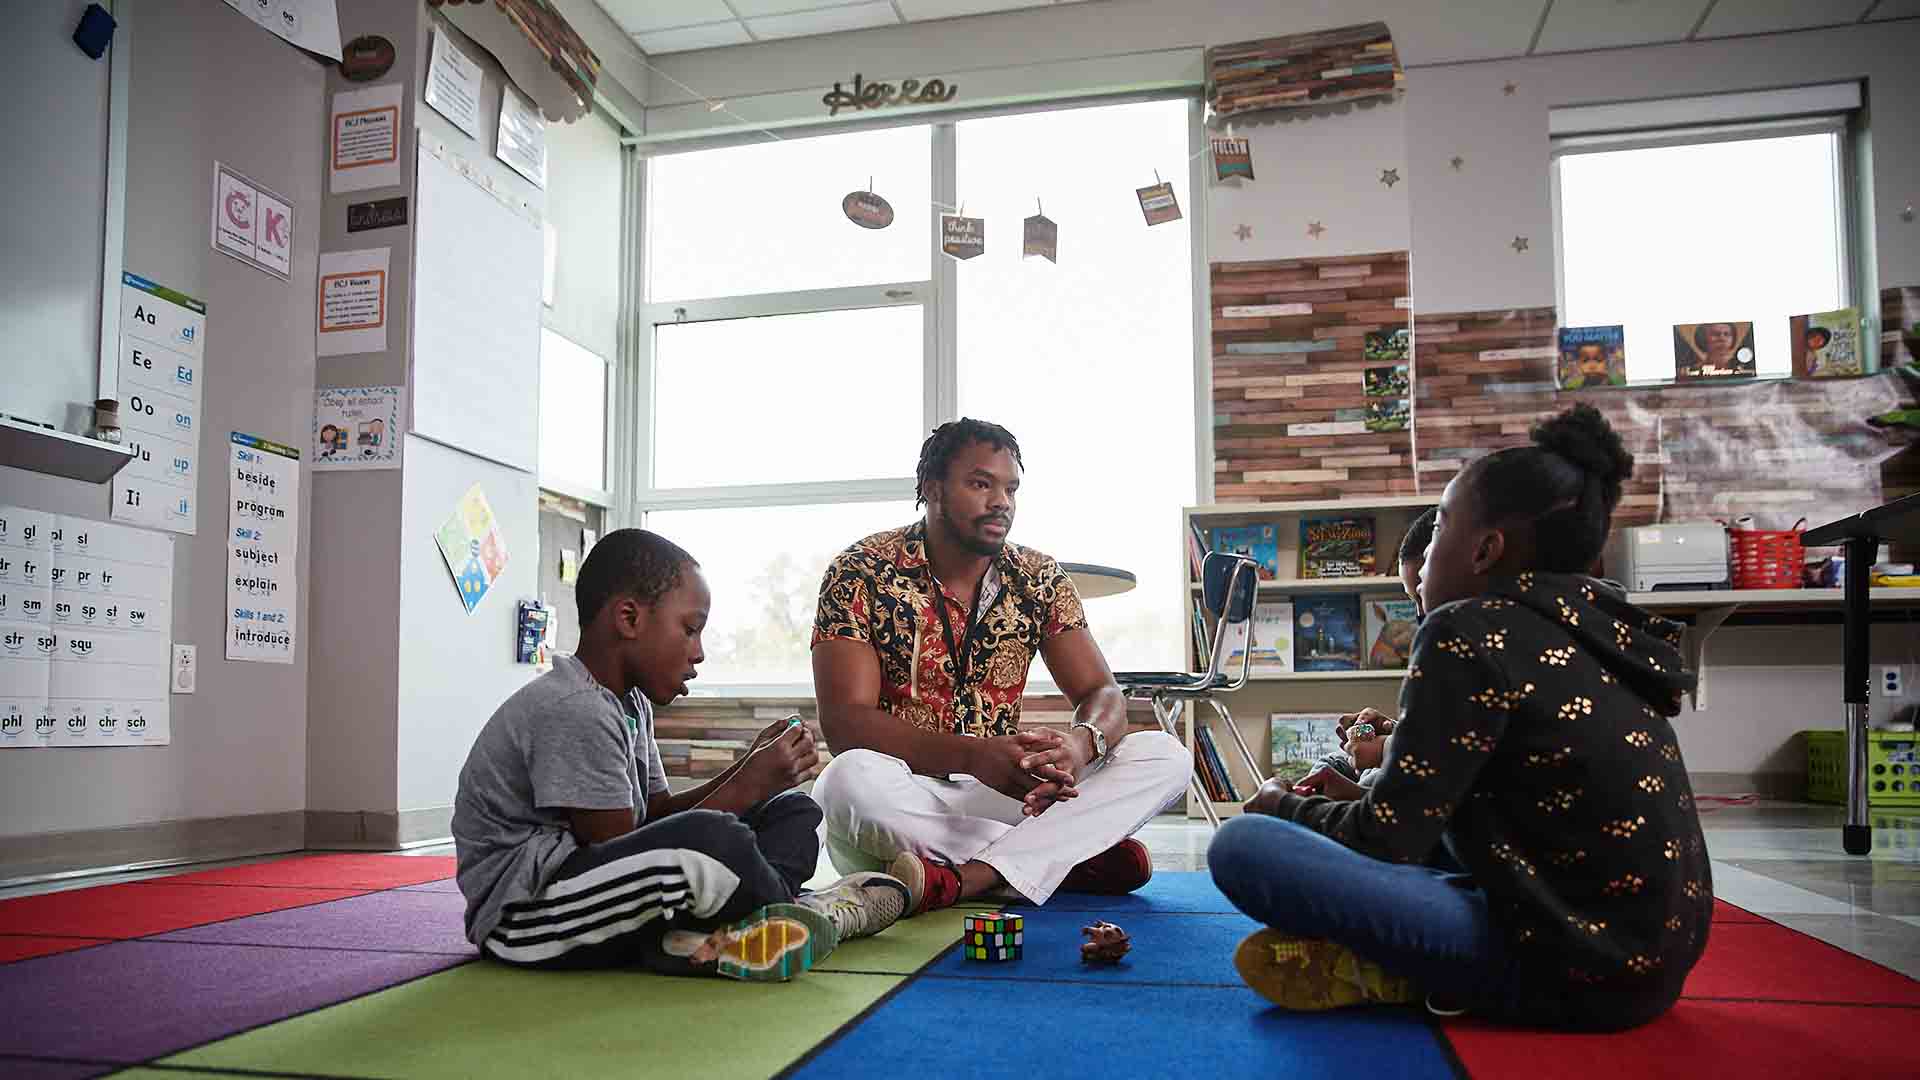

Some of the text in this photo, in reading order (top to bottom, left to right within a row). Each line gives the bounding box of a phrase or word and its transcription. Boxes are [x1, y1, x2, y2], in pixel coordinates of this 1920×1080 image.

[947, 220, 975, 233] think
[134, 304, 156, 326] Aa
[132, 350, 193, 382] Ee Ed
[130, 395, 191, 426] Oo on
[173, 457, 189, 471] up
[237, 468, 276, 488] beside
[179, 498, 188, 513] it
[237, 499, 285, 518] program
[24, 525, 36, 540] gl
[51, 529, 63, 544] pl
[77, 533, 88, 545] sl
[235, 527, 253, 538] Skill
[235, 548, 278, 564] subject
[24, 560, 37, 574] fr
[51, 567, 66, 581] gr
[78, 571, 91, 584] pr
[102, 571, 113, 584] tr
[235, 576, 278, 592] explain
[23, 600, 41, 611] sm
[55, 602, 71, 613] sn
[82, 605, 96, 618] sp
[106, 605, 118, 618] st
[130, 610, 146, 621] sw
[234, 608, 254, 620] Skills
[4, 631, 92, 652] str spl squ
[235, 628, 290, 646] introduce
[2, 714, 146, 731] phl phr chl chr sch
